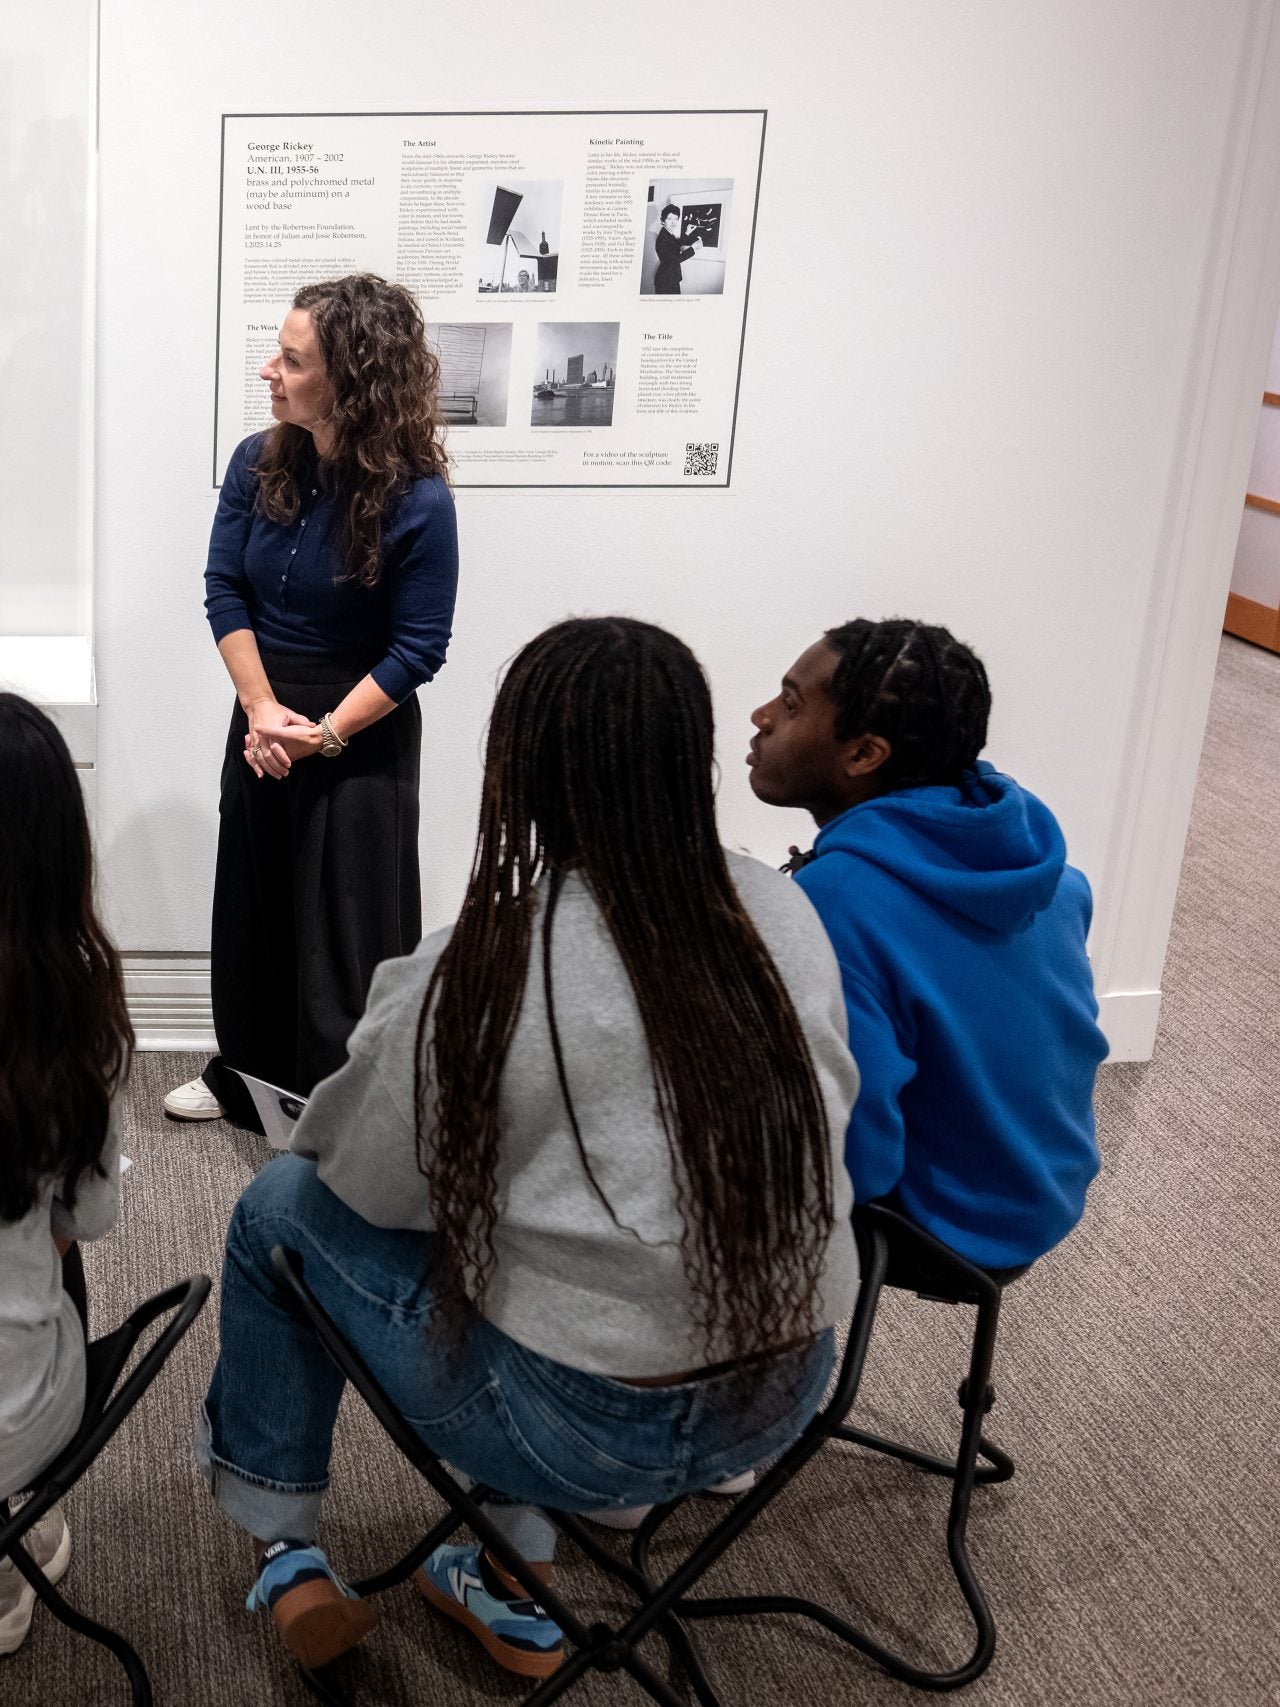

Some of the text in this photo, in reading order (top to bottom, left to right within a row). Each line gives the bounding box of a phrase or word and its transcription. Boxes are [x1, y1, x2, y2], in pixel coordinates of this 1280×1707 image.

[247, 142, 313, 152] George Rickey
[615, 138, 644, 147] Painting
[247, 155, 292, 163] American,
[270, 166, 283, 175] III,
[246, 178, 269, 186] brass
[290, 178, 348, 188] polychromed
[246, 190, 279, 200] (maybe
[280, 190, 329, 199] aluminum)
[261, 224, 269, 232] by
[281, 233, 301, 241] Julian
[638, 451, 668, 459] sculpture
[644, 459, 655, 468] QR
